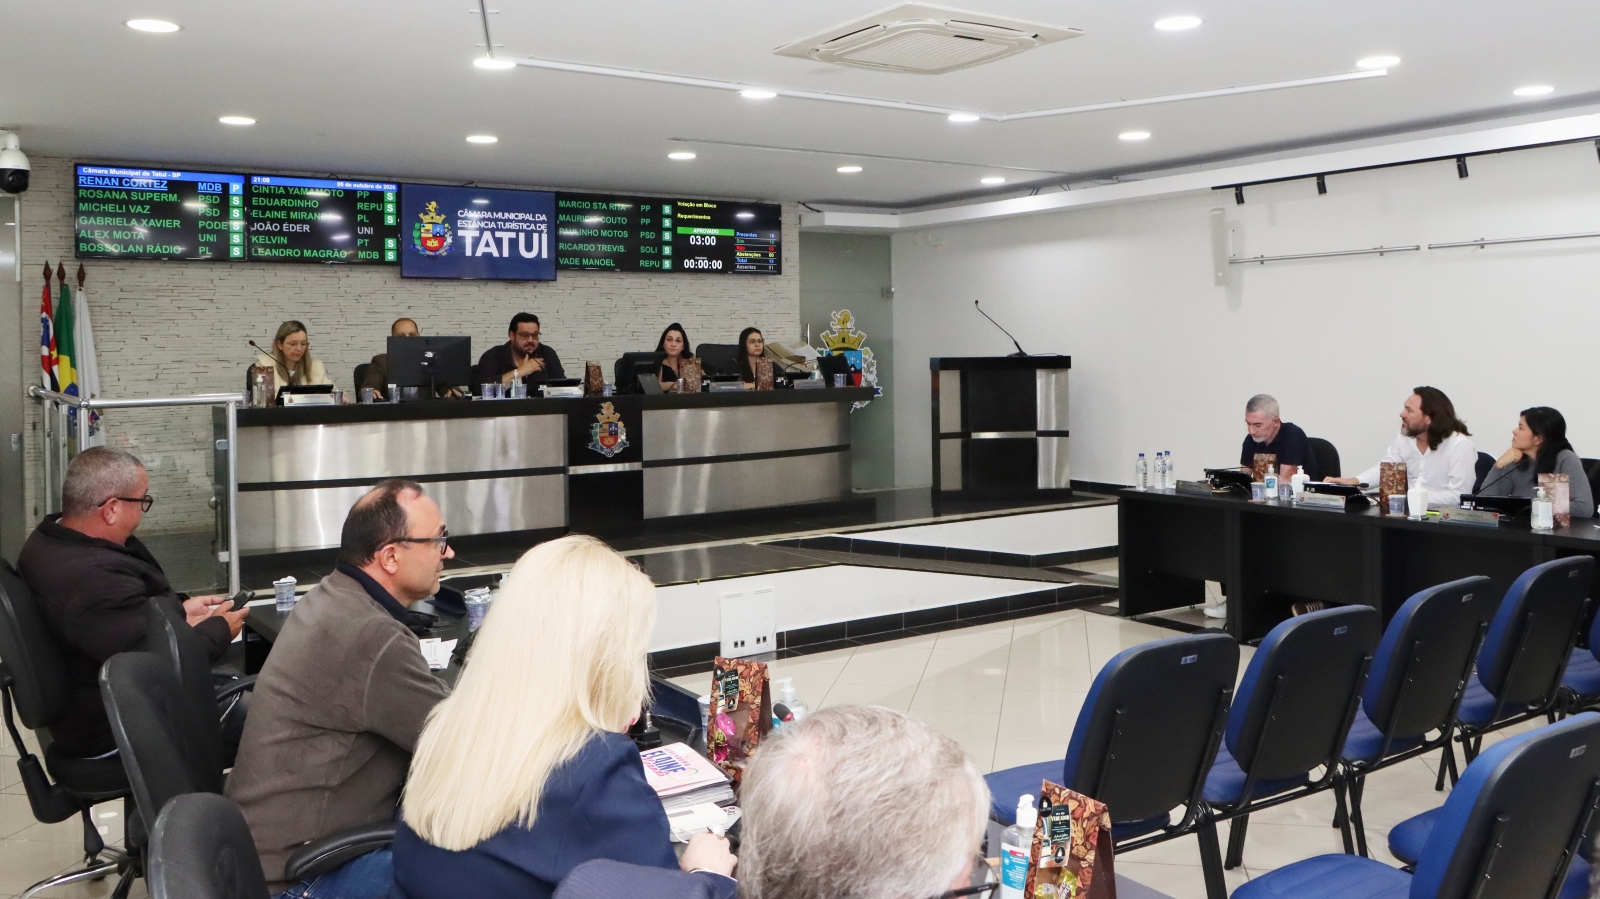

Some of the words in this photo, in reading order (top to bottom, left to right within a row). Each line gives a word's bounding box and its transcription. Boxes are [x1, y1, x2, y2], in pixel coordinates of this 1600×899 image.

[110, 168, 140, 177] Municipal
[79, 176, 118, 186] RENAN
[122, 178, 168, 189] CORTEZ
[198, 183, 222, 191] MDB
[232, 184, 240, 192] P
[252, 185, 285, 195] CINTIA
[287, 187, 344, 197] YAMAMOTO
[79, 190, 127, 199] ROSANA
[131, 192, 180, 202] SUPERM.
[232, 197, 240, 205] S
[252, 197, 318, 208] EDUARDINHO
[357, 203, 382, 211] REPU
[609, 203, 626, 211] RITA
[79, 203, 126, 213] MICHELI
[129, 205, 150, 214] VAZ
[199, 208, 220, 216] PSD
[232, 209, 240, 217] S
[252, 210, 287, 219] ELAINE
[458, 209, 493, 219] CÂMARA
[494, 212, 536, 220] MUNICIPAL
[79, 216, 139, 227] GABRIELA
[141, 219, 181, 228] XAVIER
[199, 221, 228, 230] PODE
[232, 222, 240, 230] S
[458, 219, 496, 228] ESTÂNCIA
[497, 221, 536, 230] TURÍSTICA
[601, 216, 627, 224] COUTO
[252, 221, 279, 231] JOÃO
[283, 222, 310, 232] ÉDER
[79, 230, 109, 239] ALEX
[113, 231, 144, 240] MOTA
[199, 234, 216, 242] UNI
[232, 235, 240, 243] S
[559, 228, 598, 236] PAULINHO
[601, 230, 628, 238] MOTOS
[252, 236, 287, 244] KELVIN
[458, 230, 548, 258] TATUÍ
[690, 235, 716, 245] 03:00
[80, 243, 143, 253] BOSSOLAN
[147, 243, 181, 254] RÁDIO
[199, 246, 212, 255] PL
[232, 247, 240, 255] S
[559, 243, 595, 251] RICARDO
[252, 248, 300, 257] LEANDRO
[304, 249, 347, 258] MAGRÃO
[684, 259, 722, 269] 00:00:00
[641, 750, 686, 772] ELAINE
